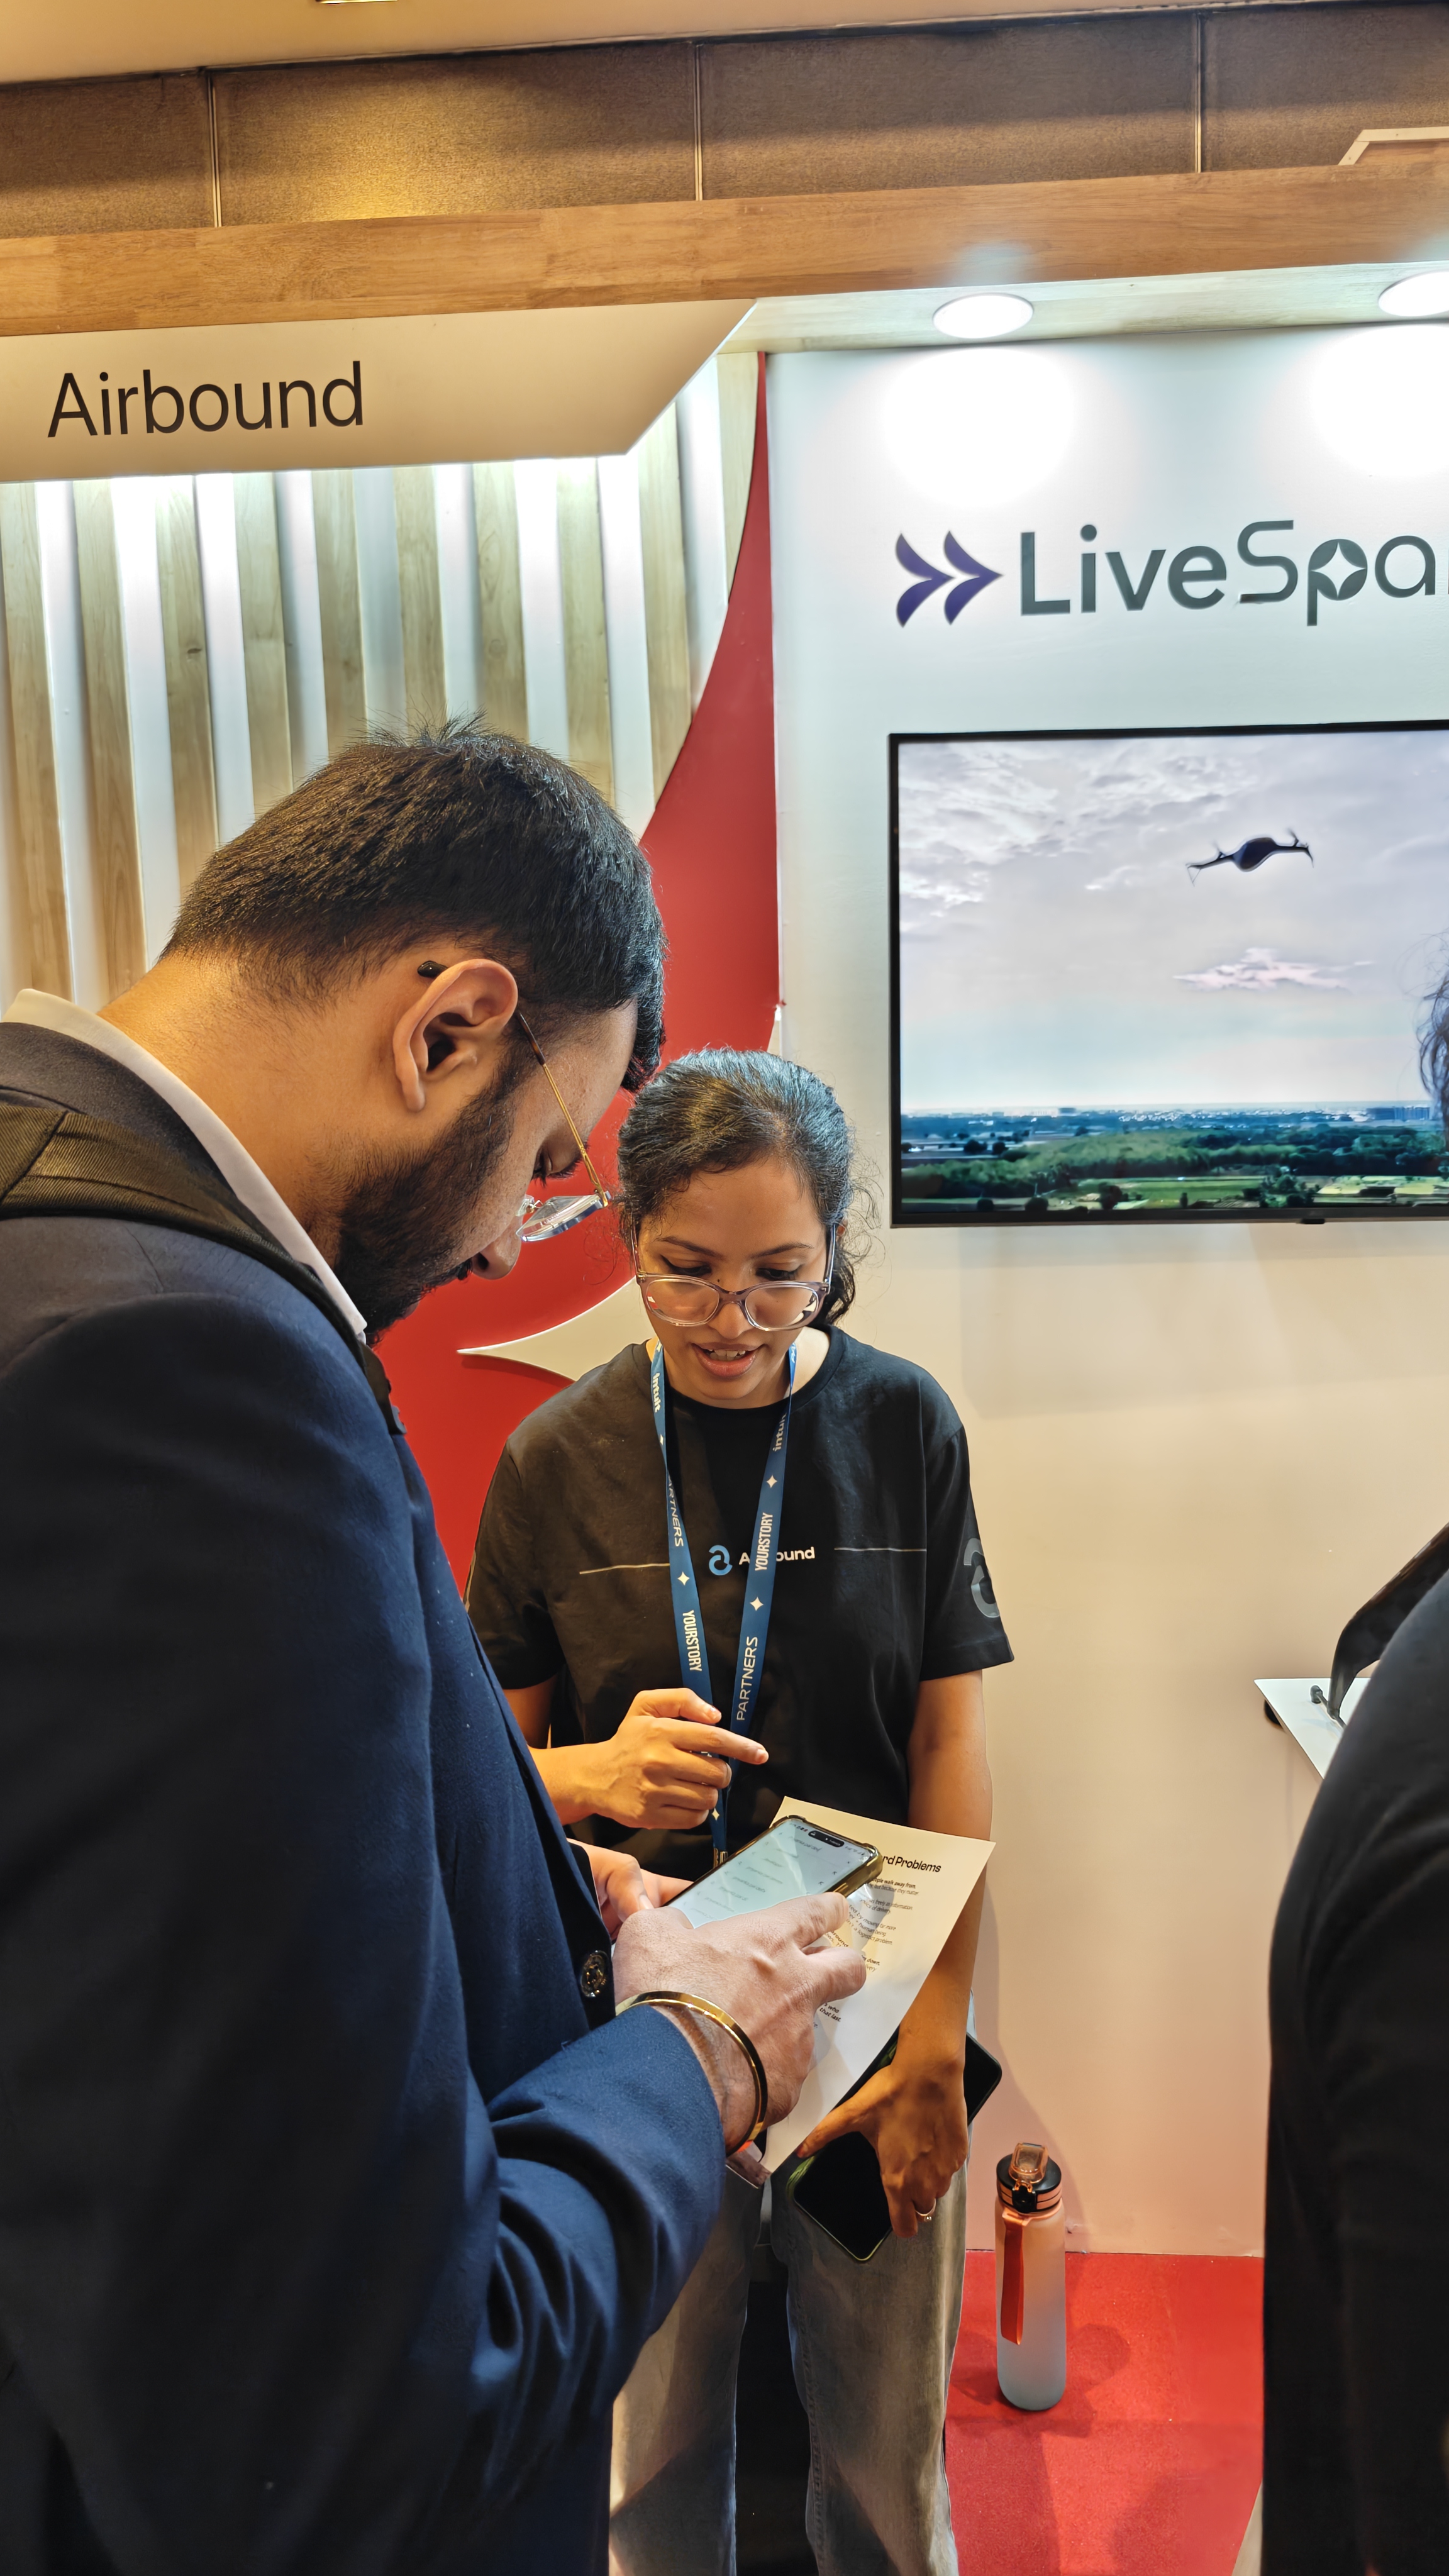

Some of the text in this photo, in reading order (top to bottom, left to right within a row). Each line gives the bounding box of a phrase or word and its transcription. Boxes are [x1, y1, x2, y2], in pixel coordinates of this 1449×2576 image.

[47, 360, 364, 438] Airbound
[1020, 519, 1449, 627] LiveSpa
[668, 1475, 684, 1547] ARTNERS
[754, 1512, 774, 1572] YOURSTORY
[738, 1546, 816, 1565] Aound
[682, 1609, 702, 1672] YOURSTORY
[736, 1636, 758, 1721] PARTNERS
[882, 1855, 941, 1873] rd Problems
